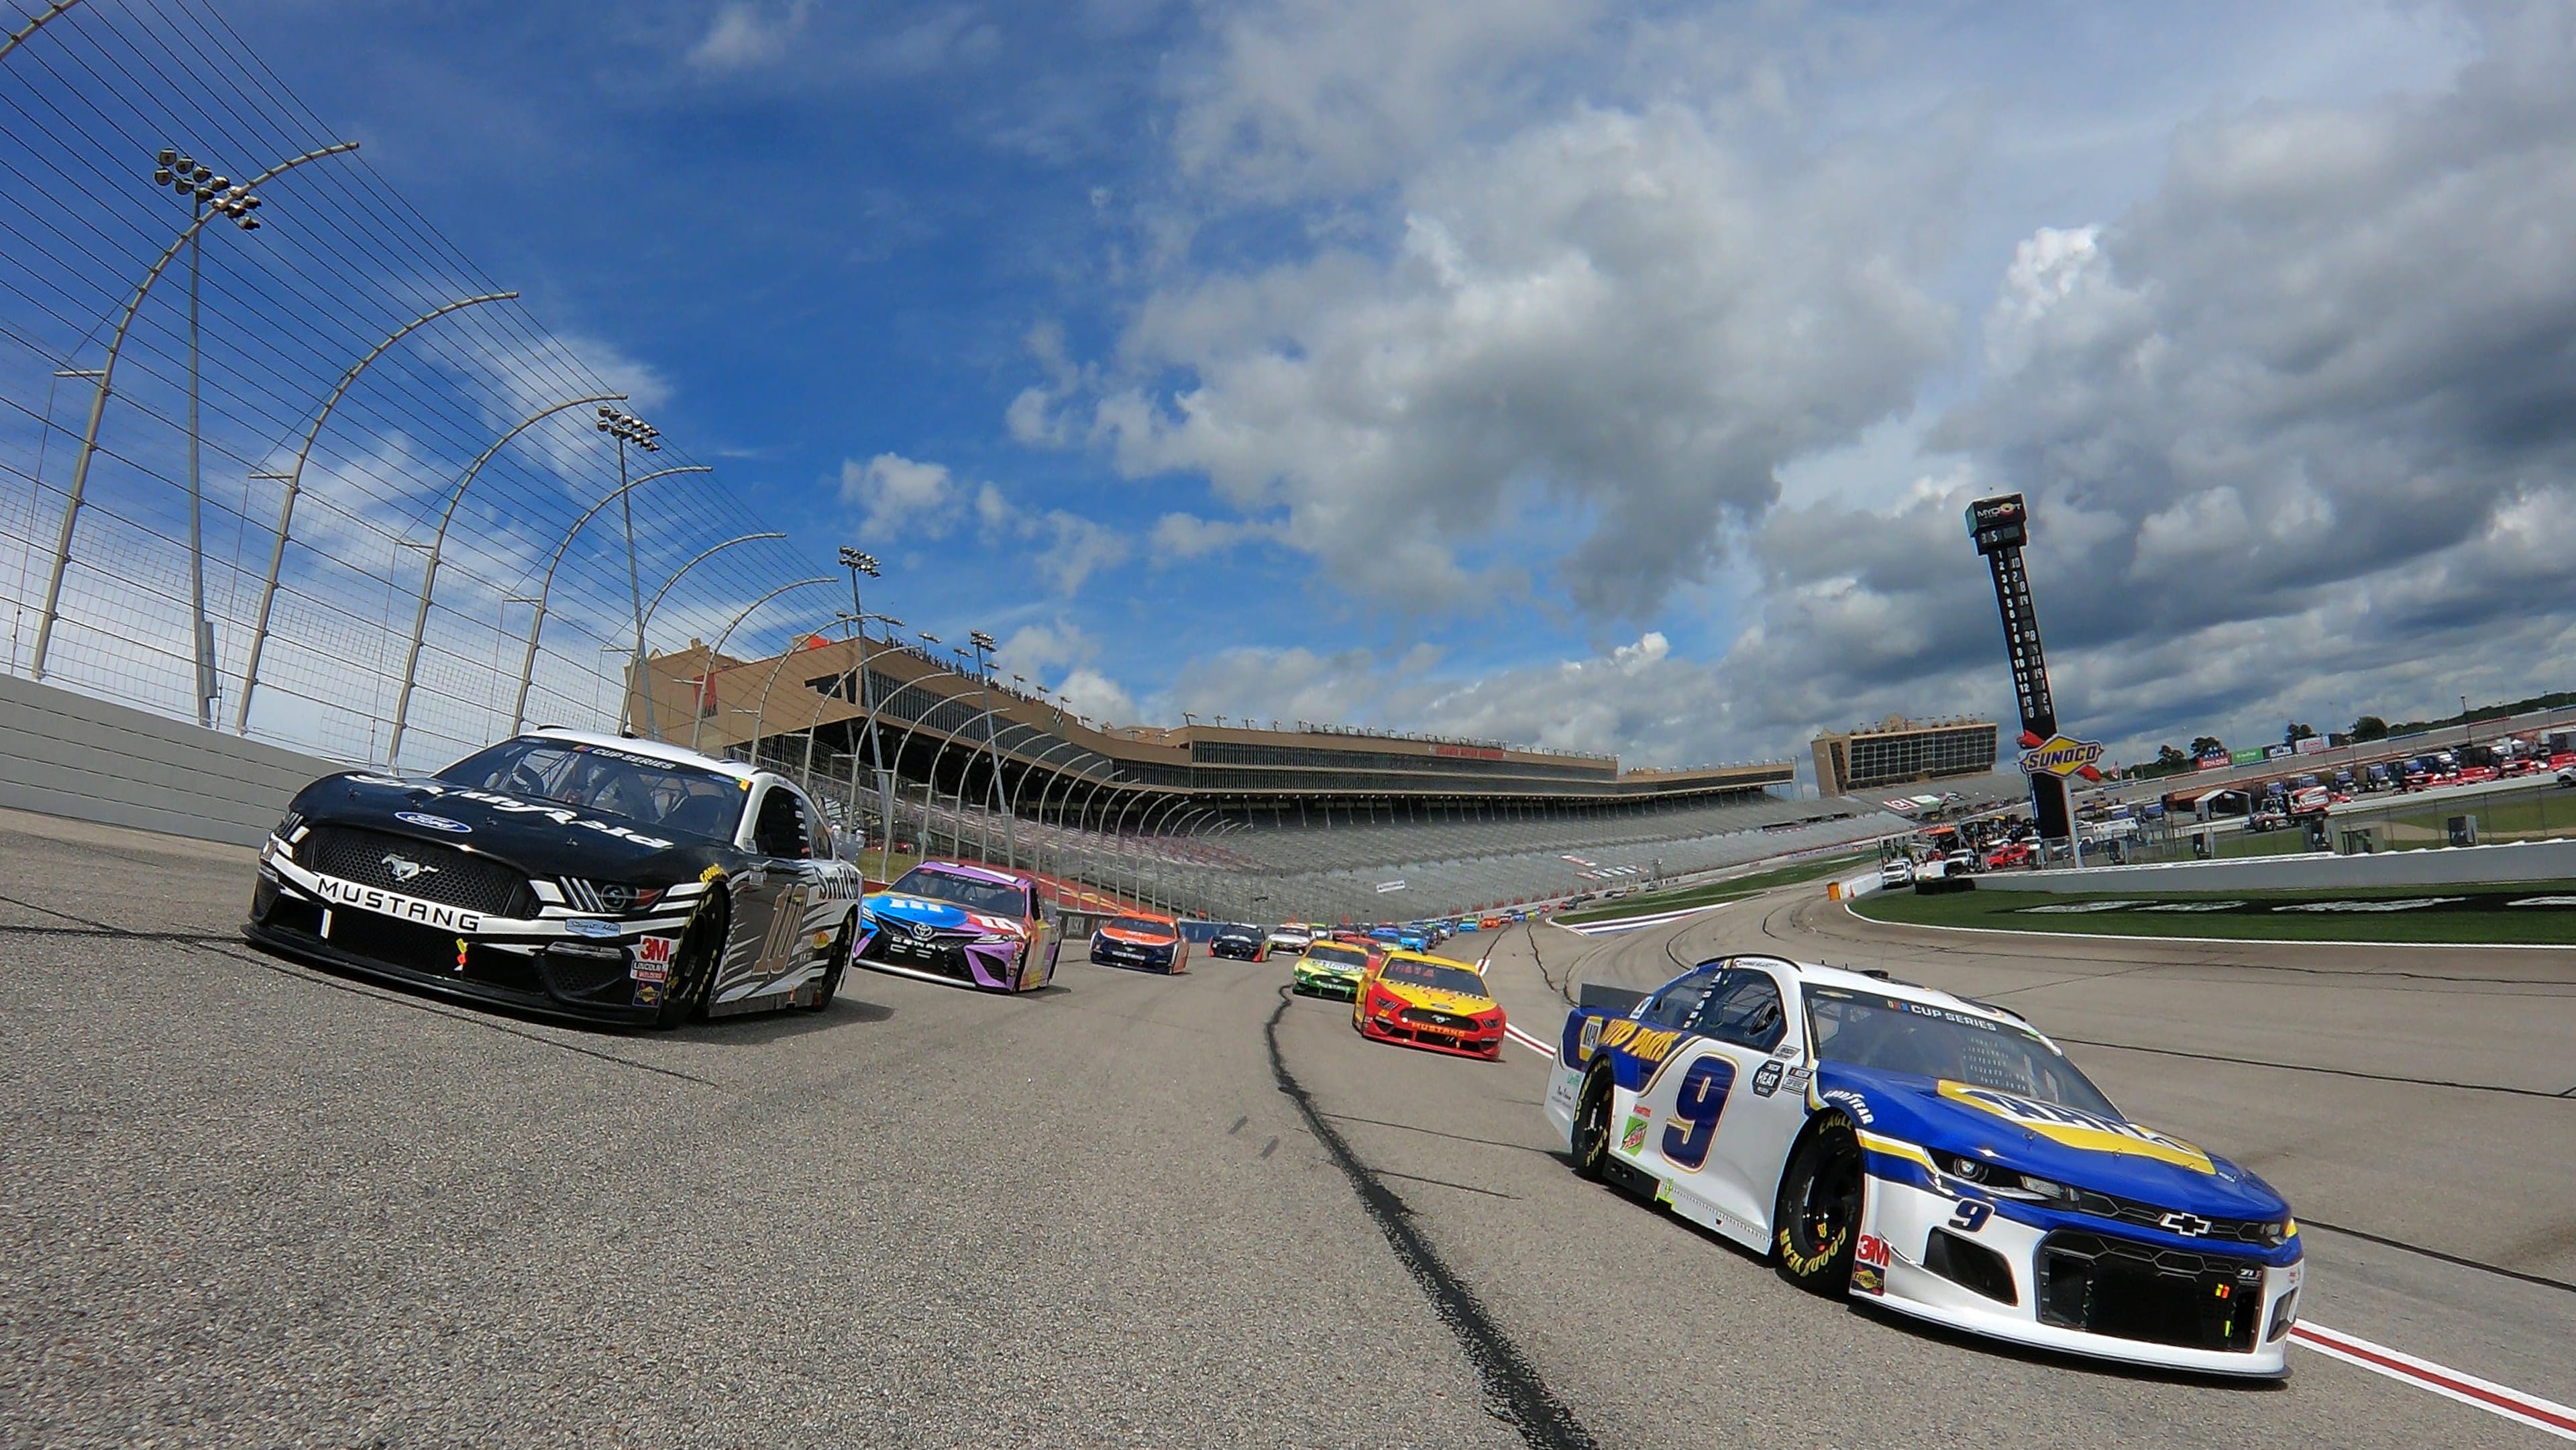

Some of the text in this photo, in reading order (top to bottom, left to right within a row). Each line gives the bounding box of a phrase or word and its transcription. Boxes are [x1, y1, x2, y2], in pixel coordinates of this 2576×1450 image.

[1999, 562, 2005, 570] 2
[2001, 574, 2008, 584] 3
[2007, 599, 2013, 607] 5
[2011, 623, 2017, 632] 7
[2015, 659, 2025, 668] 10
[2017, 672, 2028, 682] 11
[2019, 684, 2031, 693] 12
[592, 748, 676, 770] CUP SERIES
[2028, 745, 2097, 769] SUNOCO
[317, 878, 480, 932] MUSTANG
[753, 884, 808, 974] 10
[640, 937, 669, 962] 3M
[1911, 1004, 1997, 1031] CUP SERIES
[1623, 1028, 1682, 1062] PARTS
[1756, 1071, 1779, 1086] HEAT
[1660, 1052, 1739, 1173] 9
[1823, 1089, 1875, 1125] GOODYEAR
[1819, 1111, 1854, 1135] EAGLE
[1948, 1199, 1994, 1233] 9
[1779, 1226, 1847, 1278] GOODYEAR
[1858, 1234, 1891, 1267] 3M
